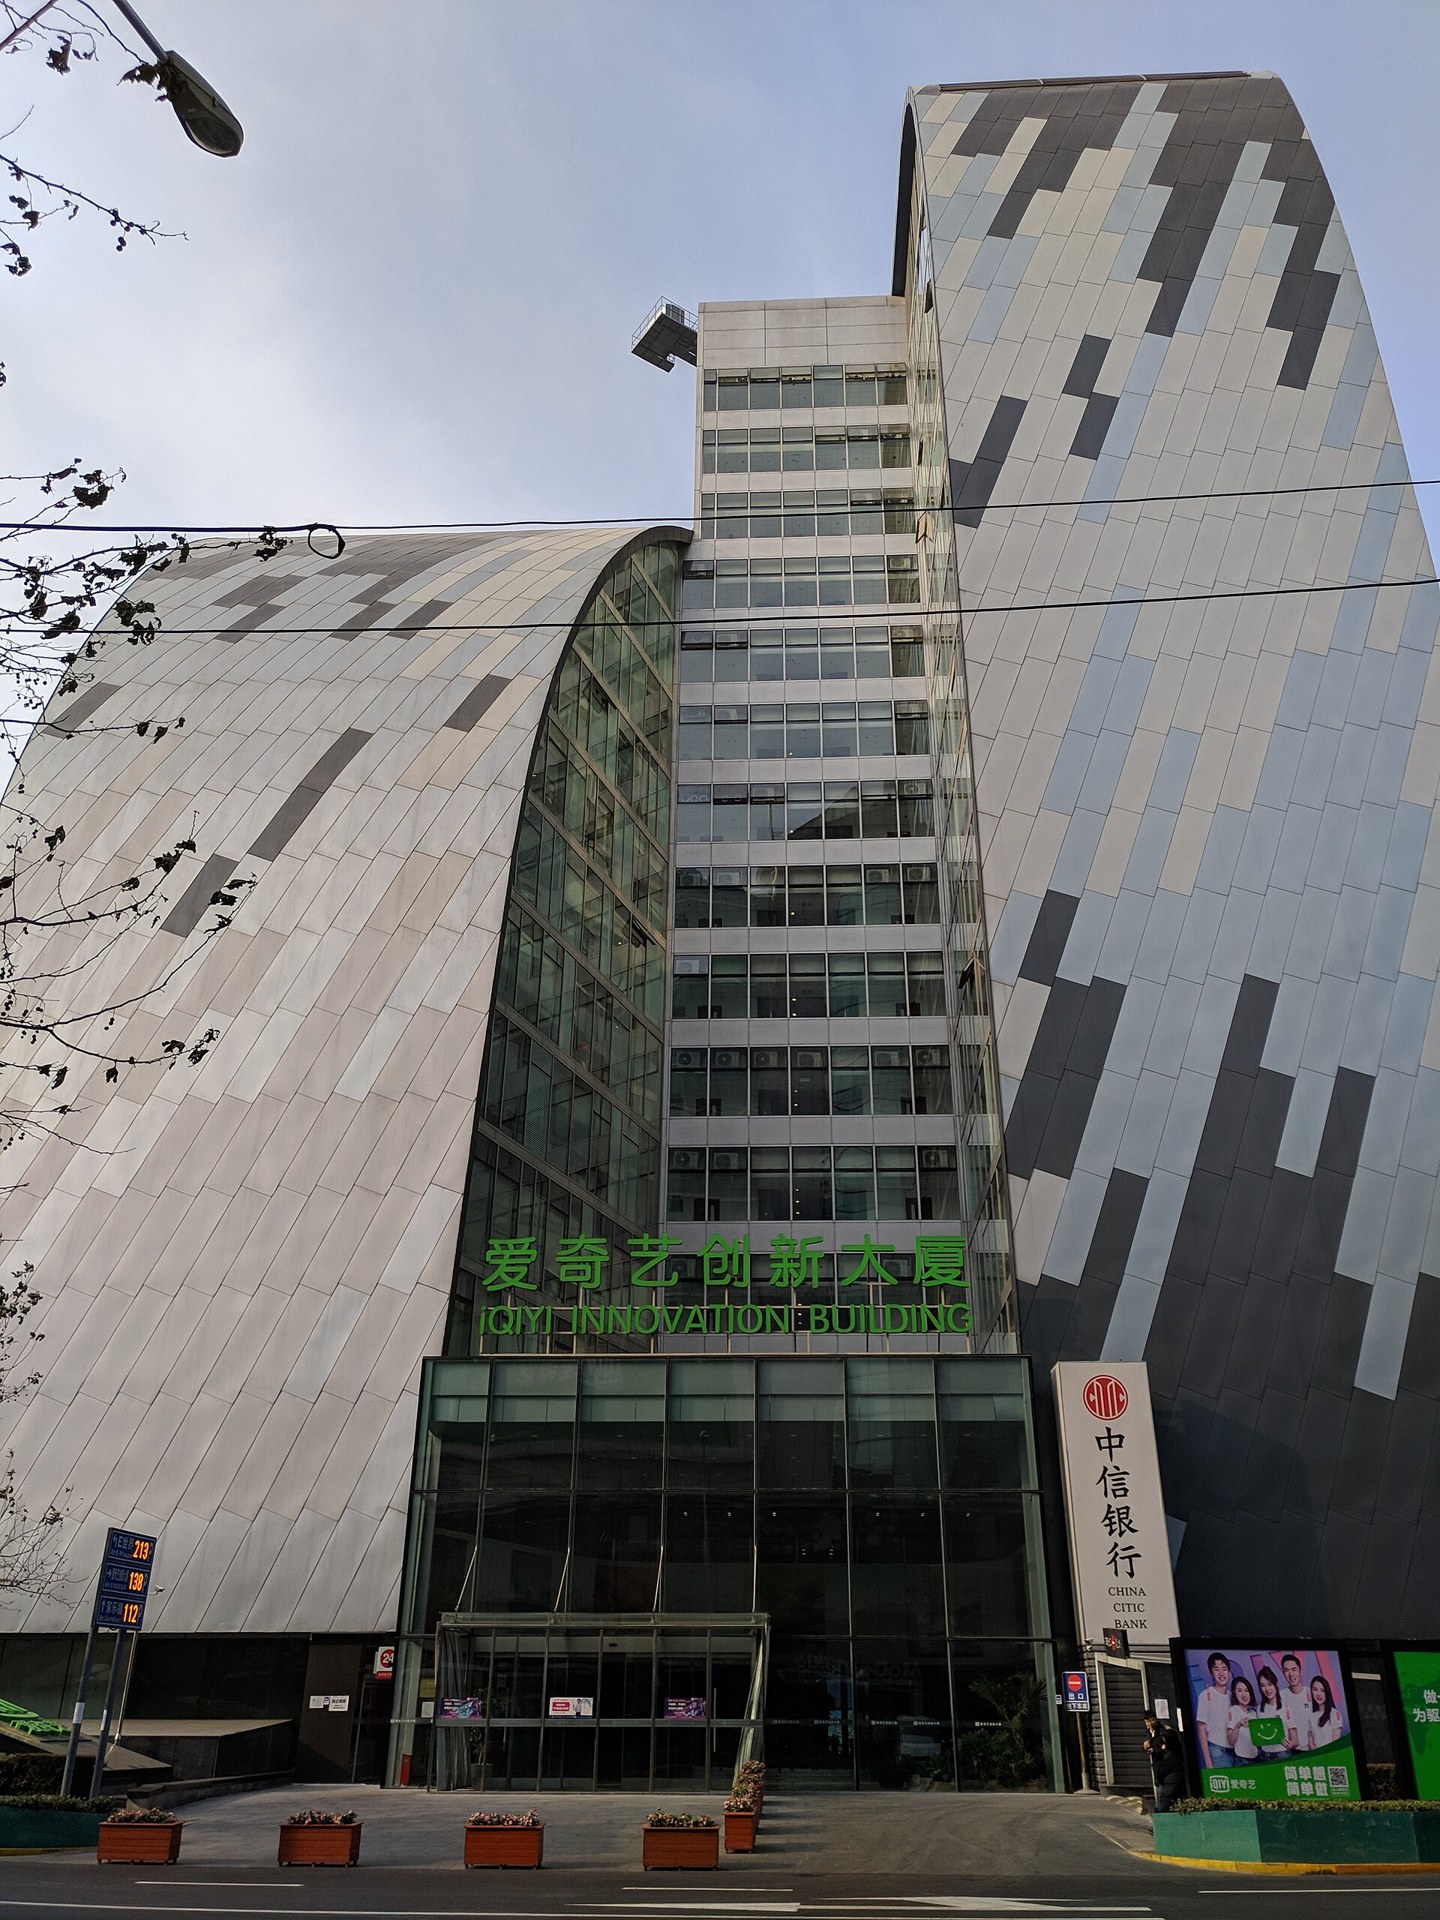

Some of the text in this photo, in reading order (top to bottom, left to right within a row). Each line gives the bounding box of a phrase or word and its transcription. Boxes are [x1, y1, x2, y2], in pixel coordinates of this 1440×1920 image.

[482, 1232, 970, 1291] 爱奇艺创新大厦
[478, 1302, 975, 1335] iQIYI INNOVATION BUILDING
[1094, 1426, 1142, 1579] 中信银行
[132, 1540, 150, 1560] 213
[128, 1571, 144, 1592] 138
[1108, 1586, 1147, 1597] CHINA
[123, 1603, 139, 1623] 112
[1113, 1602, 1145, 1613] CITIC
[1114, 1619, 1148, 1629] BANK
[382, 1652, 395, 1664] 24
[1230, 1779, 1256, 1790] 爱奇艺
